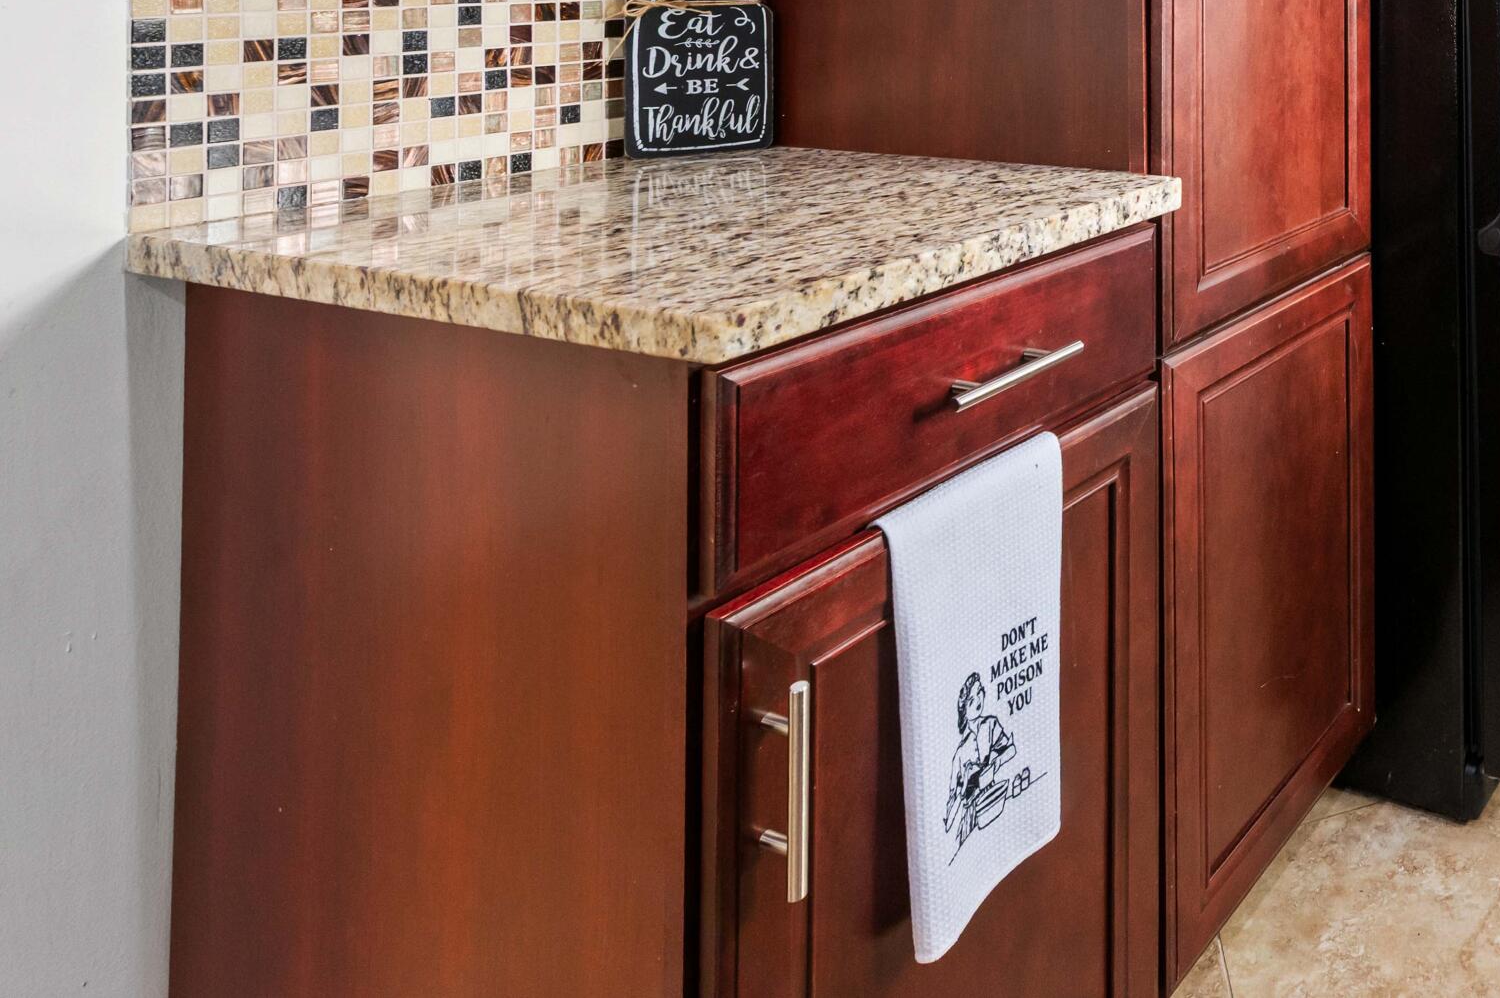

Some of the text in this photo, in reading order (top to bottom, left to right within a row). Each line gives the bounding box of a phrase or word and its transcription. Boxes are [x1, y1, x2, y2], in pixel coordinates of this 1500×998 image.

[658, 8, 726, 39] Eat
[642, 35, 760, 78] Drink &
[686, 78, 720, 95] BE
[642, 94, 761, 144] Thankful
[1001, 616, 1037, 652] DON'T
[990, 633, 1048, 683] MAKE ME
[997, 658, 1043, 701] POISON
[1008, 686, 1032, 716] YOU
